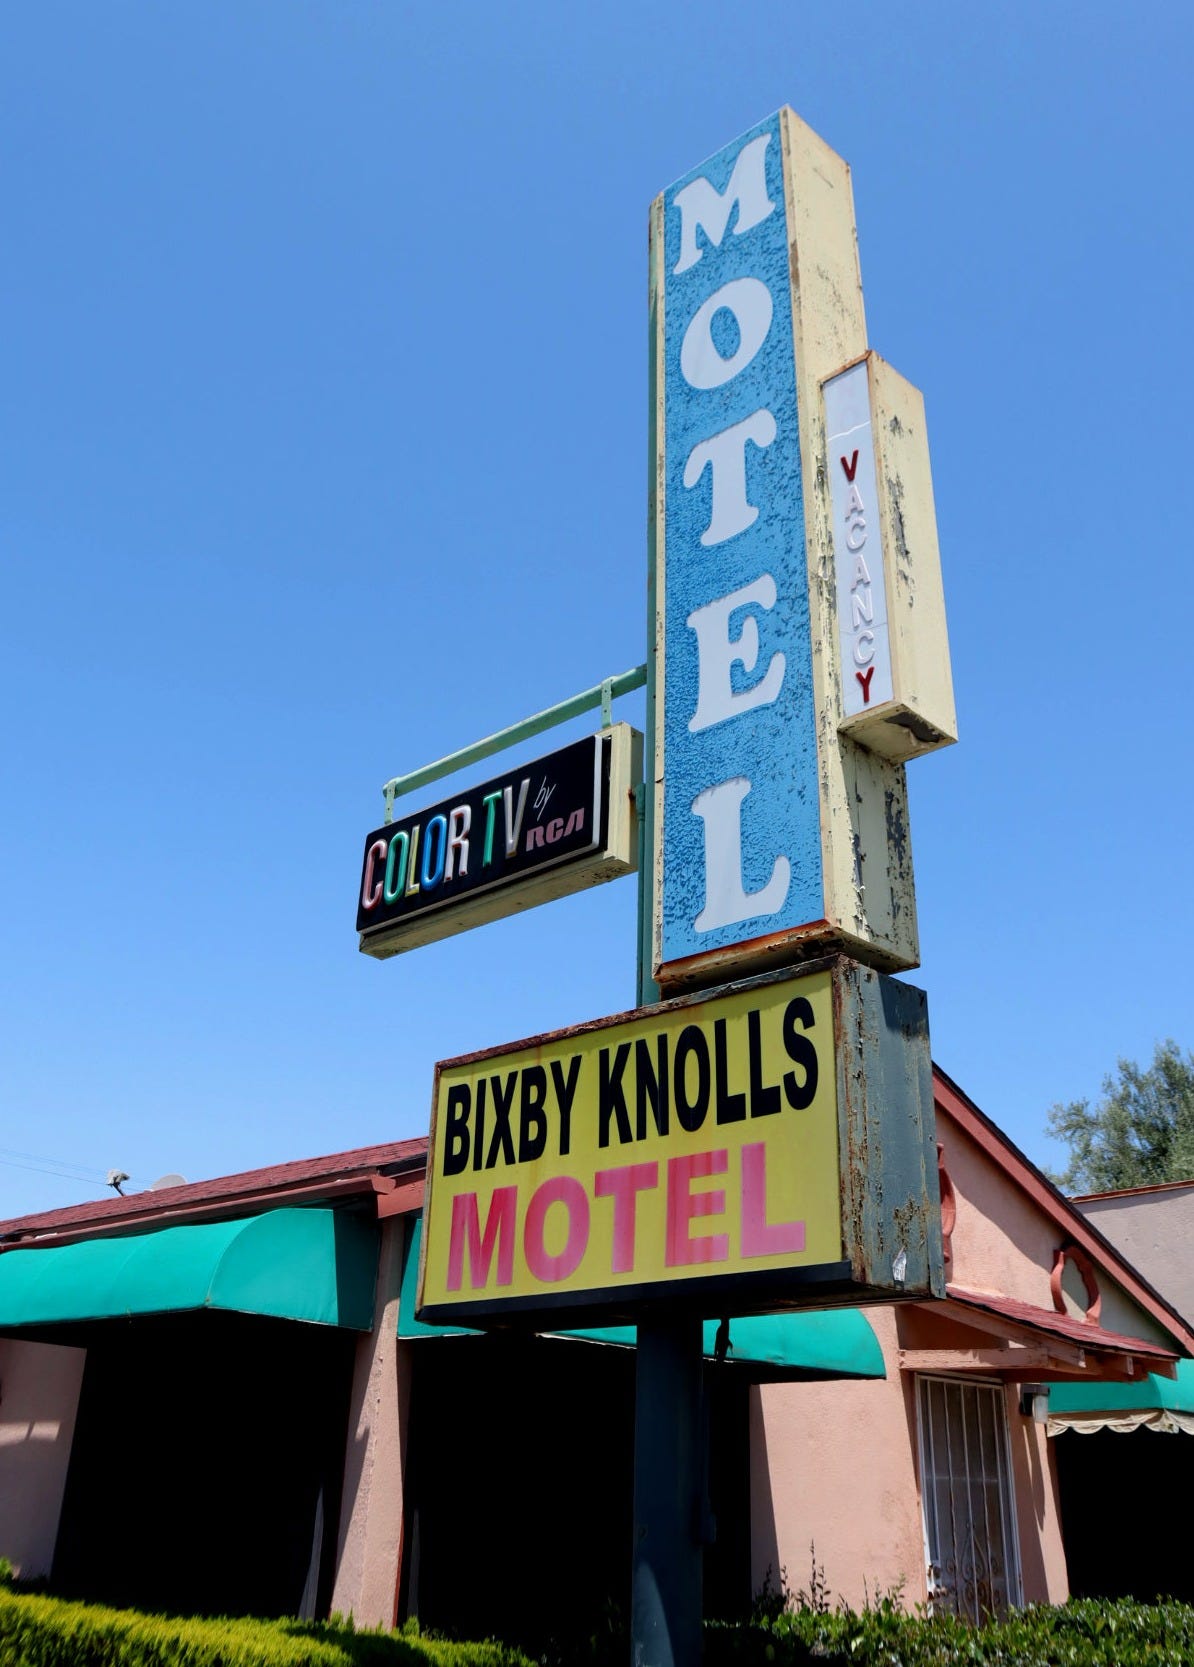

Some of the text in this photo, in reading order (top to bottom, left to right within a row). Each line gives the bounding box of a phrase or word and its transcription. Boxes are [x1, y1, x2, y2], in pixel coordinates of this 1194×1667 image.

[672, 133, 791, 936] MOTEL
[841, 451, 875, 703] VACANCY
[362, 775, 557, 909] COLOR TV by
[525, 808, 585, 852] RCA
[443, 997, 819, 1176] BIXBY KNOLLS
[447, 1142, 805, 1291] MOTEL
